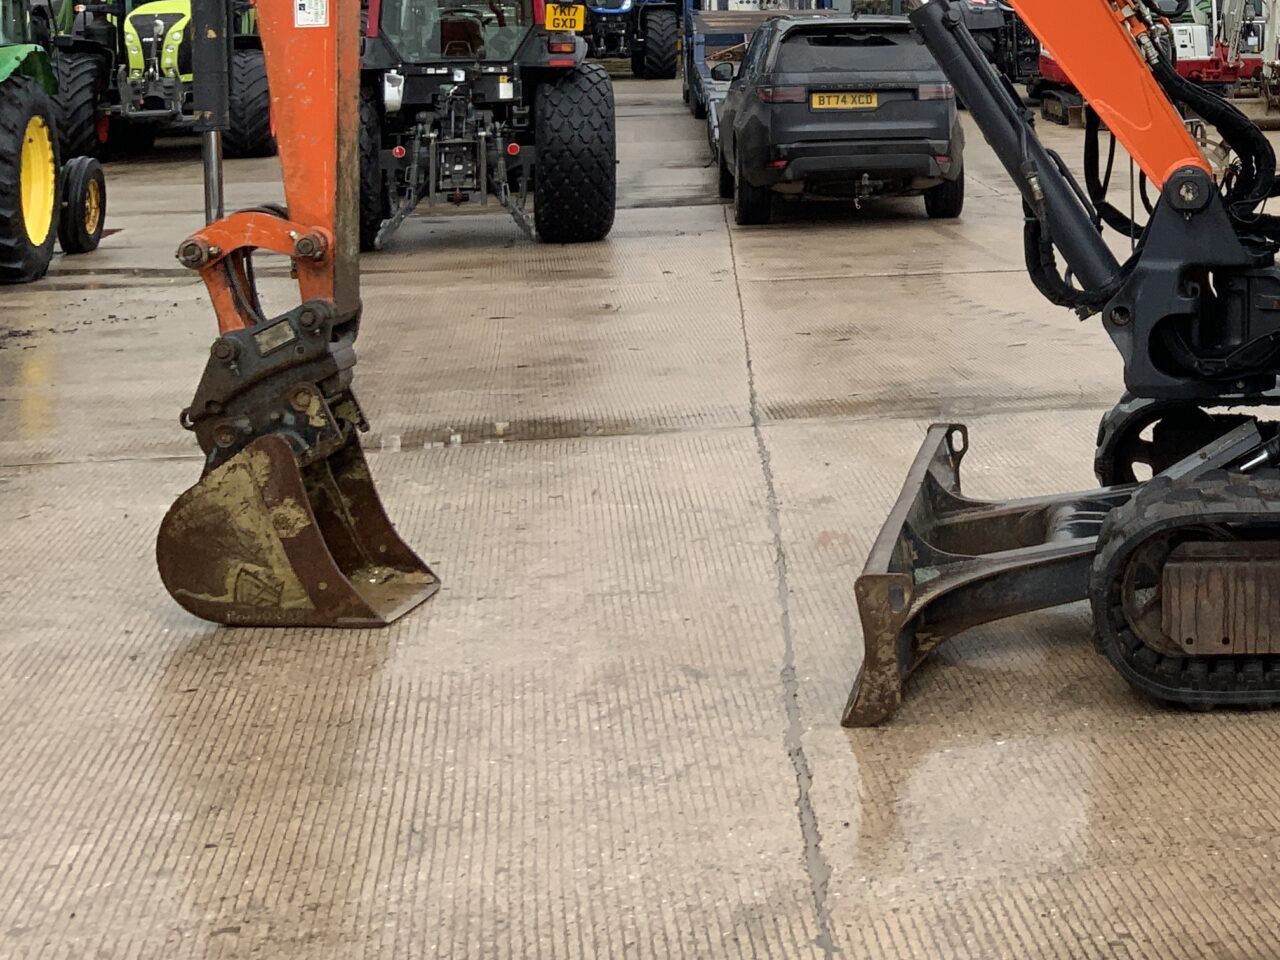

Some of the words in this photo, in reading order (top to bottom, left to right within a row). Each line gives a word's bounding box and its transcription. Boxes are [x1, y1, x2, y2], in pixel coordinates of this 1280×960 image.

[552, 5, 579, 17] YK17
[552, 17, 577, 29] GXD
[818, 95, 847, 106] BT74
[850, 94, 873, 105] XCD
